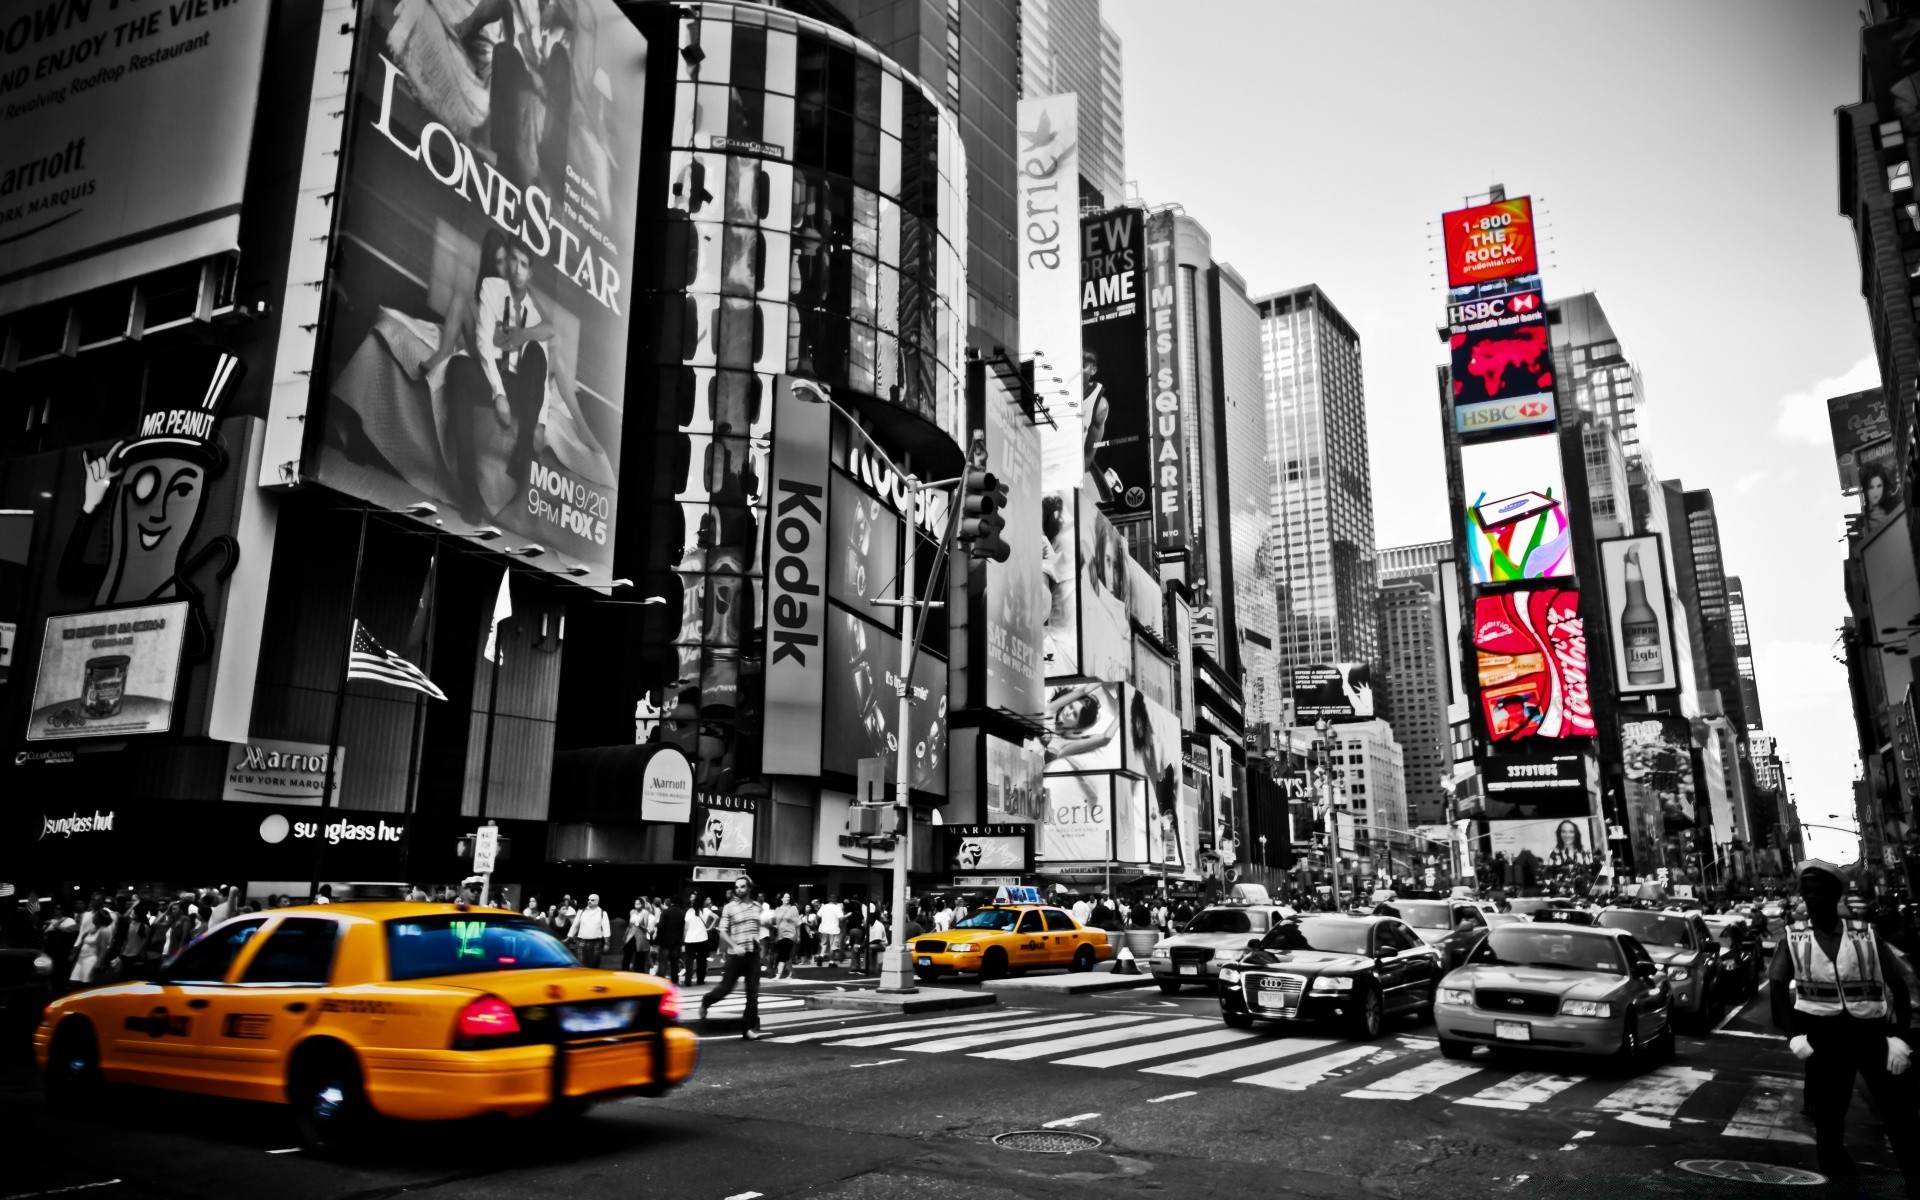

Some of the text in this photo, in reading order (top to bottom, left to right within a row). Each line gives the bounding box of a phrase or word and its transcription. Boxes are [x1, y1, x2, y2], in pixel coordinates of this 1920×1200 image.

[0, 0, 91, 53] OWN
[35, 31, 107, 80] ENJOY
[114, 10, 162, 47] THE
[6, 30, 210, 120] Revolving Rooftop Restaurant
[28, 178, 96, 214] MARQUIS
[1025, 155, 1061, 271] aerie
[1462, 212, 1512, 233] 1-800
[1469, 229, 1507, 248] THE
[1463, 256, 1523, 274] prudential.com
[1465, 242, 1516, 264] ROCK
[1450, 299, 1505, 323] HSBC
[1149, 240, 1179, 514] TIMES SQUARE
[141, 409, 215, 440] MR. PEANUT
[1462, 404, 1516, 427] HSBC
[530, 460, 609, 520] MON 9/20
[528, 488, 608, 546] 9PM FOX 5
[1162, 529, 1179, 538] NYC
[772, 479, 824, 668] Kodak
[235, 745, 337, 774] Marriot
[229, 774, 254, 785] NEW
[258, 777, 286, 787] YORK
[650, 777, 686, 790] Marriott
[697, 792, 755, 810] MARQUIS
[46, 809, 115, 839] sunglass hut
[377, 819, 404, 842] hu
[949, 825, 1027, 835] MARQUIS
[1059, 866, 1098, 875] AMERICAN
